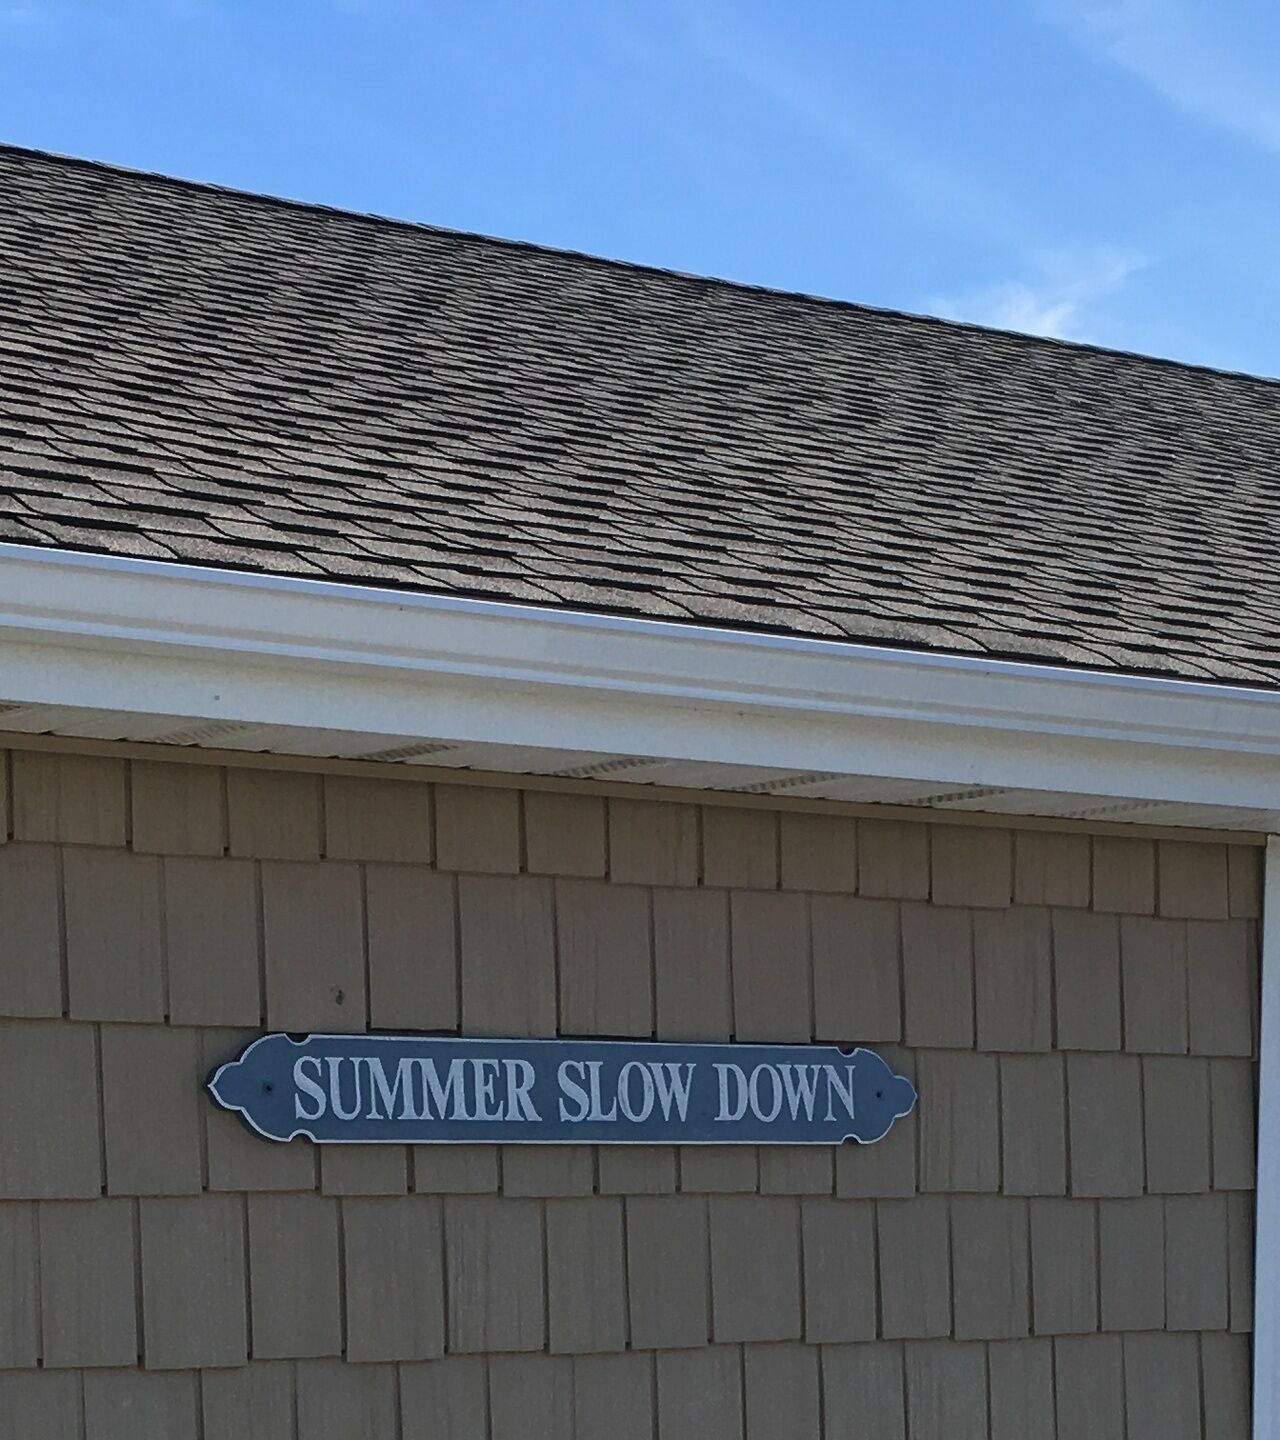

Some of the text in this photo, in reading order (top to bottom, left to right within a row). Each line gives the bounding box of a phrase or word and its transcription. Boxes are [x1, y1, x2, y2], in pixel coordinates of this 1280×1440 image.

[292, 1056, 856, 1123] SUMMER SLOW DOWN
